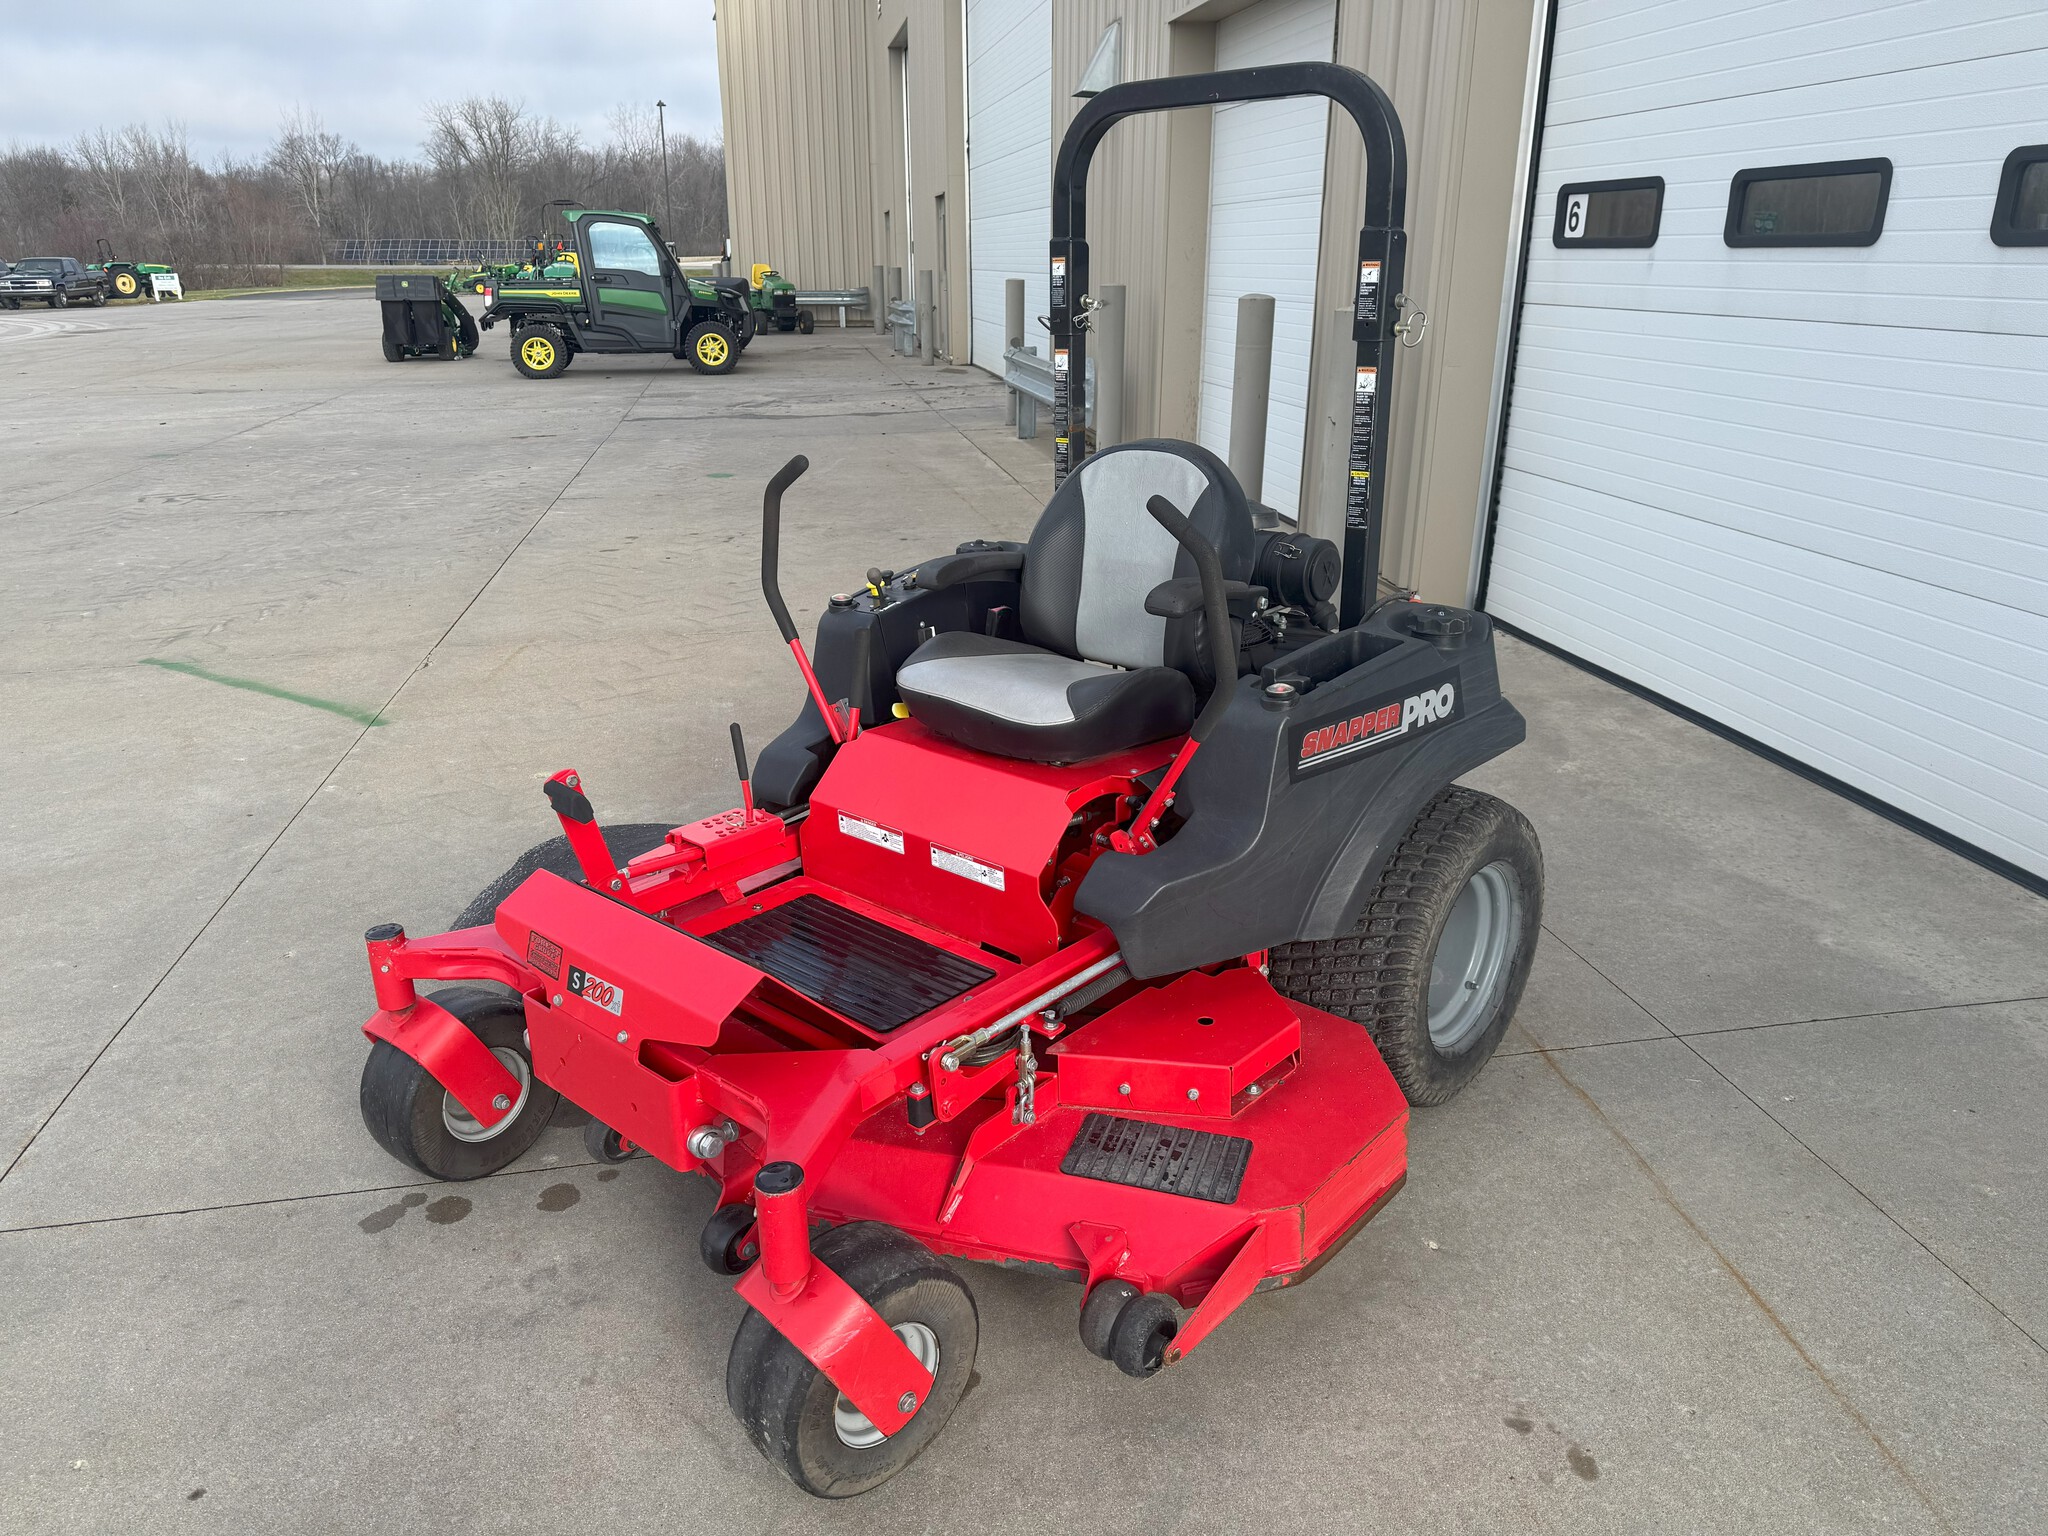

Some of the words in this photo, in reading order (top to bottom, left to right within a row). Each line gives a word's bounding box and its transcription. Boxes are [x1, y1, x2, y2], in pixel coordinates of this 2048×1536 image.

[1568, 201, 1581, 232] 6
[1300, 702, 1401, 759] SNAPPER
[1400, 682, 1455, 734] PRO
[572, 971, 580, 990] S
[581, 976, 615, 1008] 200
